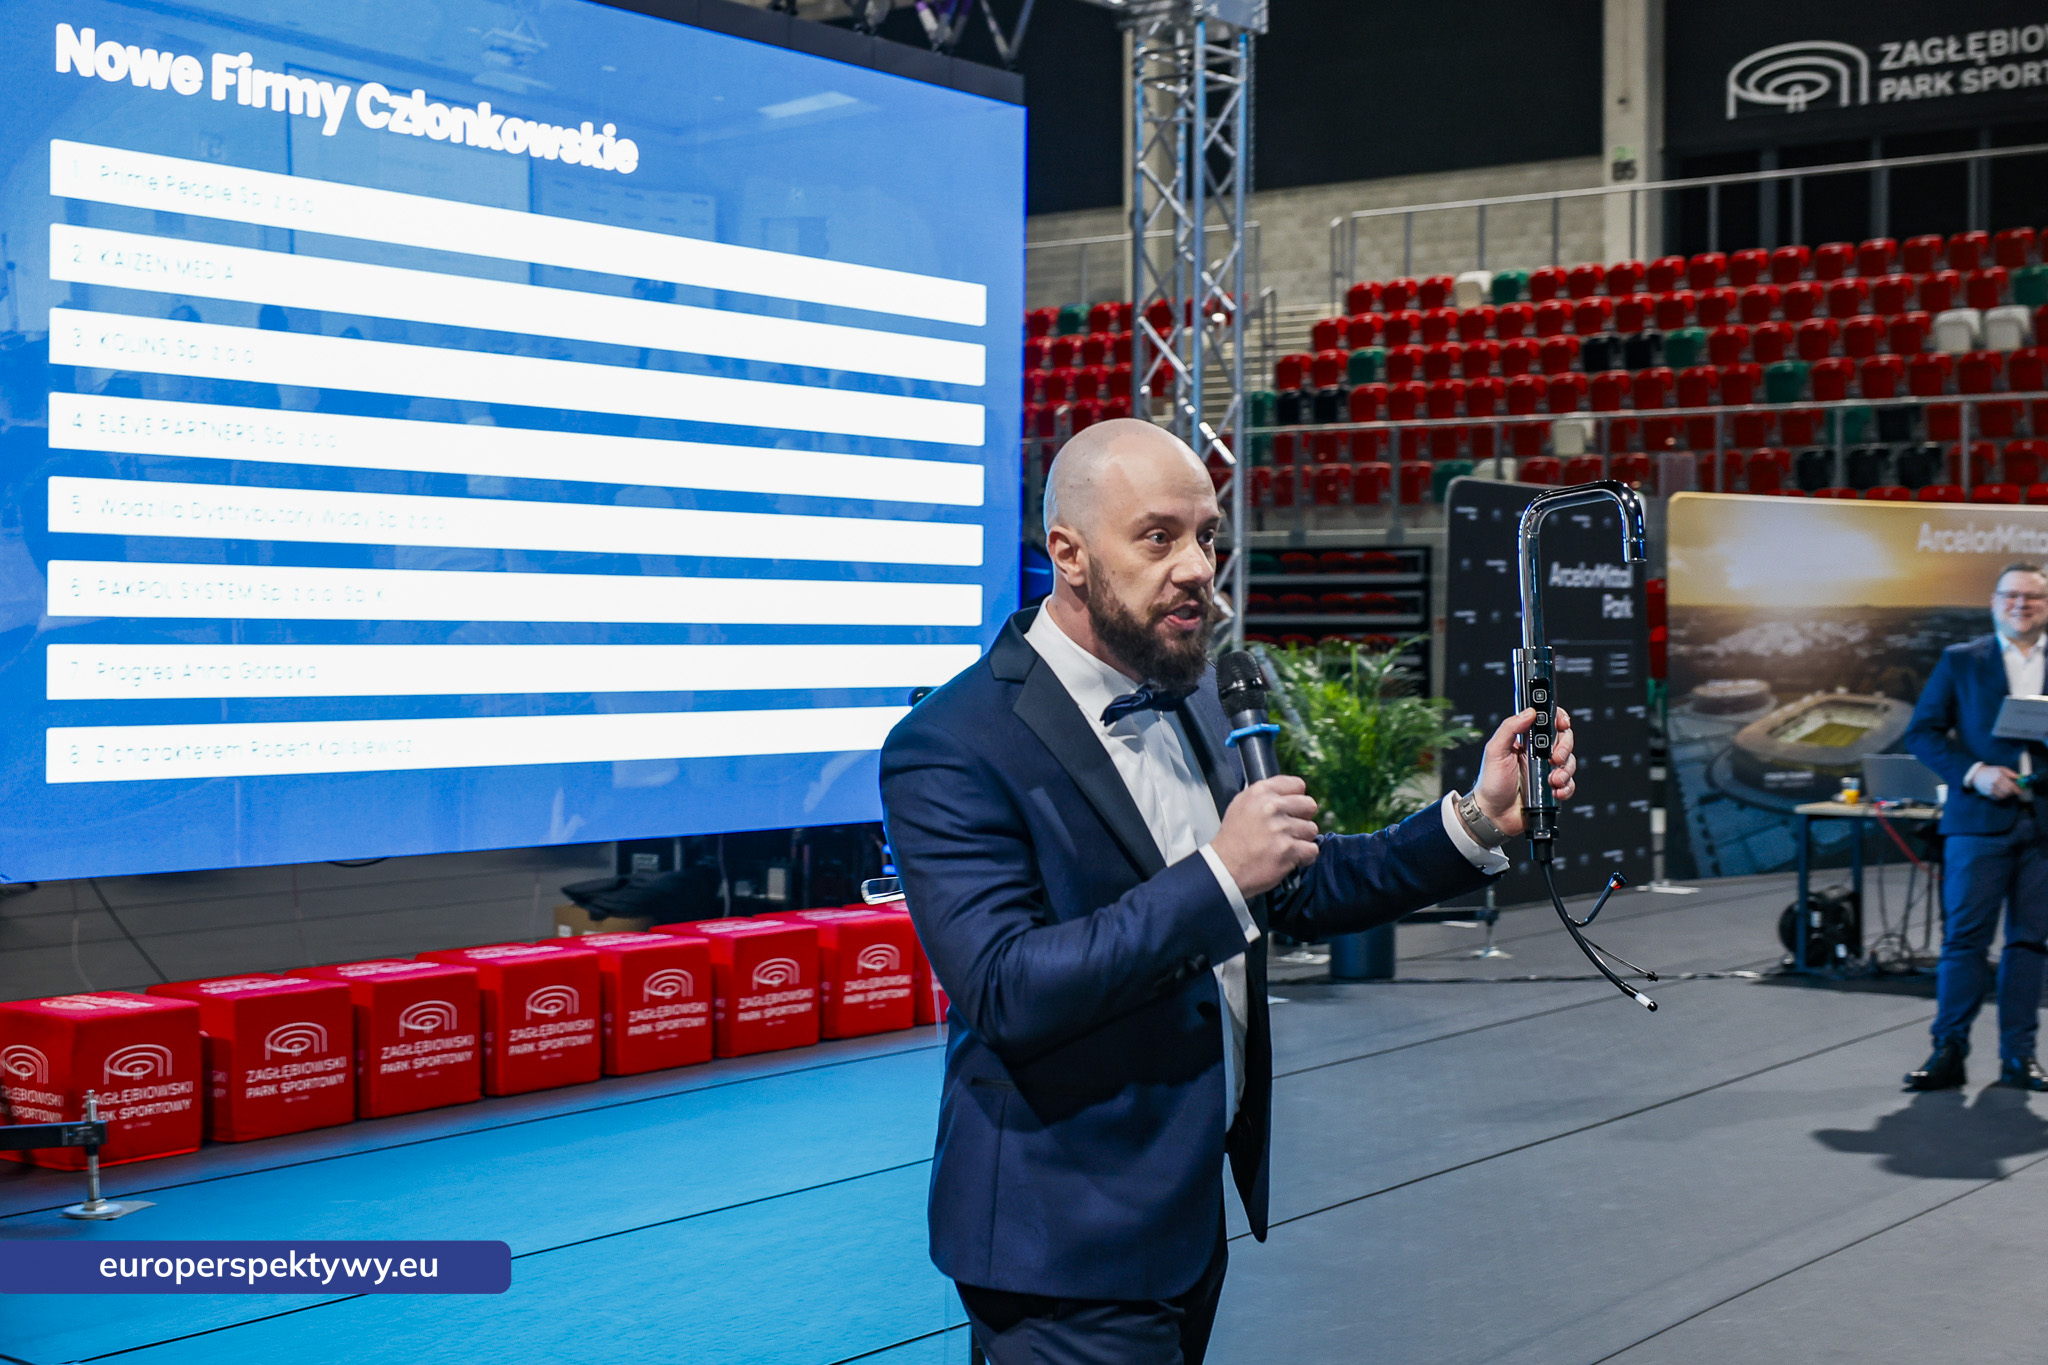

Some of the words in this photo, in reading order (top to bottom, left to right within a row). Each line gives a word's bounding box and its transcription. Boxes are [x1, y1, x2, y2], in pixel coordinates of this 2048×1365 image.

[1879, 24, 2048, 71] ZAGŁĘBIO
[56, 23, 203, 95] Nowe
[211, 52, 351, 136] Firmy
[1879, 71, 1954, 104] PARK
[100, 164, 158, 191] Prime
[166, 174, 233, 205] People
[99, 249, 168, 274] KAIZEN
[176, 257, 235, 280] MEDIA
[180, 581, 253, 601] SYSTEM
[96, 661, 174, 688] Progres
[182, 661, 232, 680] Anna
[245, 1056, 347, 1084] ZAGŁĘBIOWSKI
[380, 1060, 411, 1075] PARK
[412, 1050, 474, 1070] SPORTOWY
[245, 1082, 279, 1099] PARK
[280, 1072, 347, 1096] SPORTOWY
[119, 1098, 193, 1121] SPORTOWY
